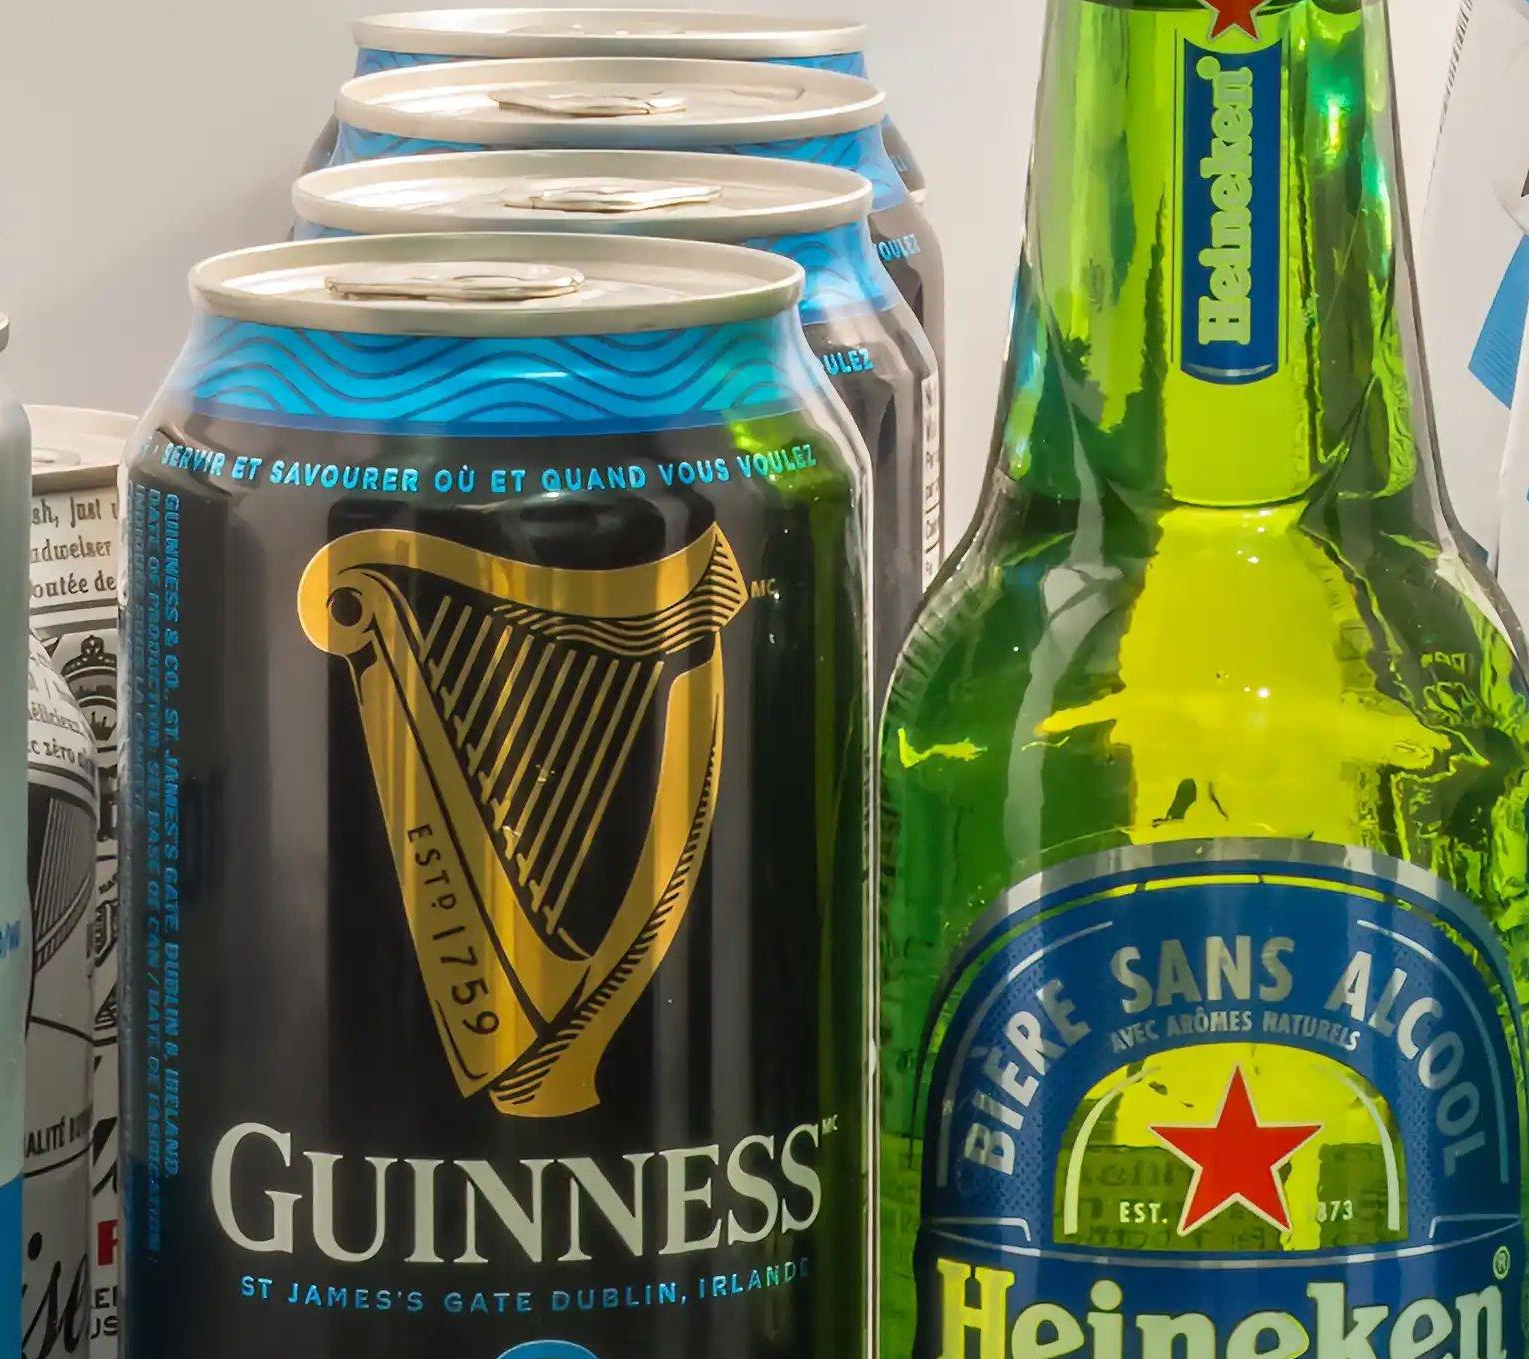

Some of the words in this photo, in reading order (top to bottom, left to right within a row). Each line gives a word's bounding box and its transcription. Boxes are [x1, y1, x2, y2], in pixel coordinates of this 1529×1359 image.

[1197, 67, 1254, 346] Heineken
[161, 442, 226, 477] SERVIR
[232, 456, 262, 480] ET
[270, 460, 419, 493] SAVOURER
[434, 462, 476, 493] OÙ
[491, 468, 527, 493] ET
[542, 465, 647, 493] QUAND
[658, 458, 731, 488] VOUS
[737, 442, 818, 482] VOULEZ
[163, 493, 180, 622] GUINNESS
[162, 941, 180, 1036] DUBLIN
[431, 926, 501, 1036] 1759
[1110, 1018, 1159, 1053] AVEC
[1167, 1007, 1253, 1037] ARÔMES
[1262, 1010, 1361, 1053] NATURELS
[963, 978, 1092, 1176] BIÈRE
[1109, 934, 1296, 1014] SANS
[1325, 949, 1489, 1178] ALCOOL
[211, 1121, 823, 1264] GUINNESS
[1119, 1200, 1168, 1226] EST.
[238, 1275, 272, 1300] ST
[288, 1280, 424, 1313] JAMES'S
[444, 1290, 533, 1314] GATE
[552, 1280, 687, 1313] DUBLIN,
[698, 1256, 811, 1301] IRLANDE
